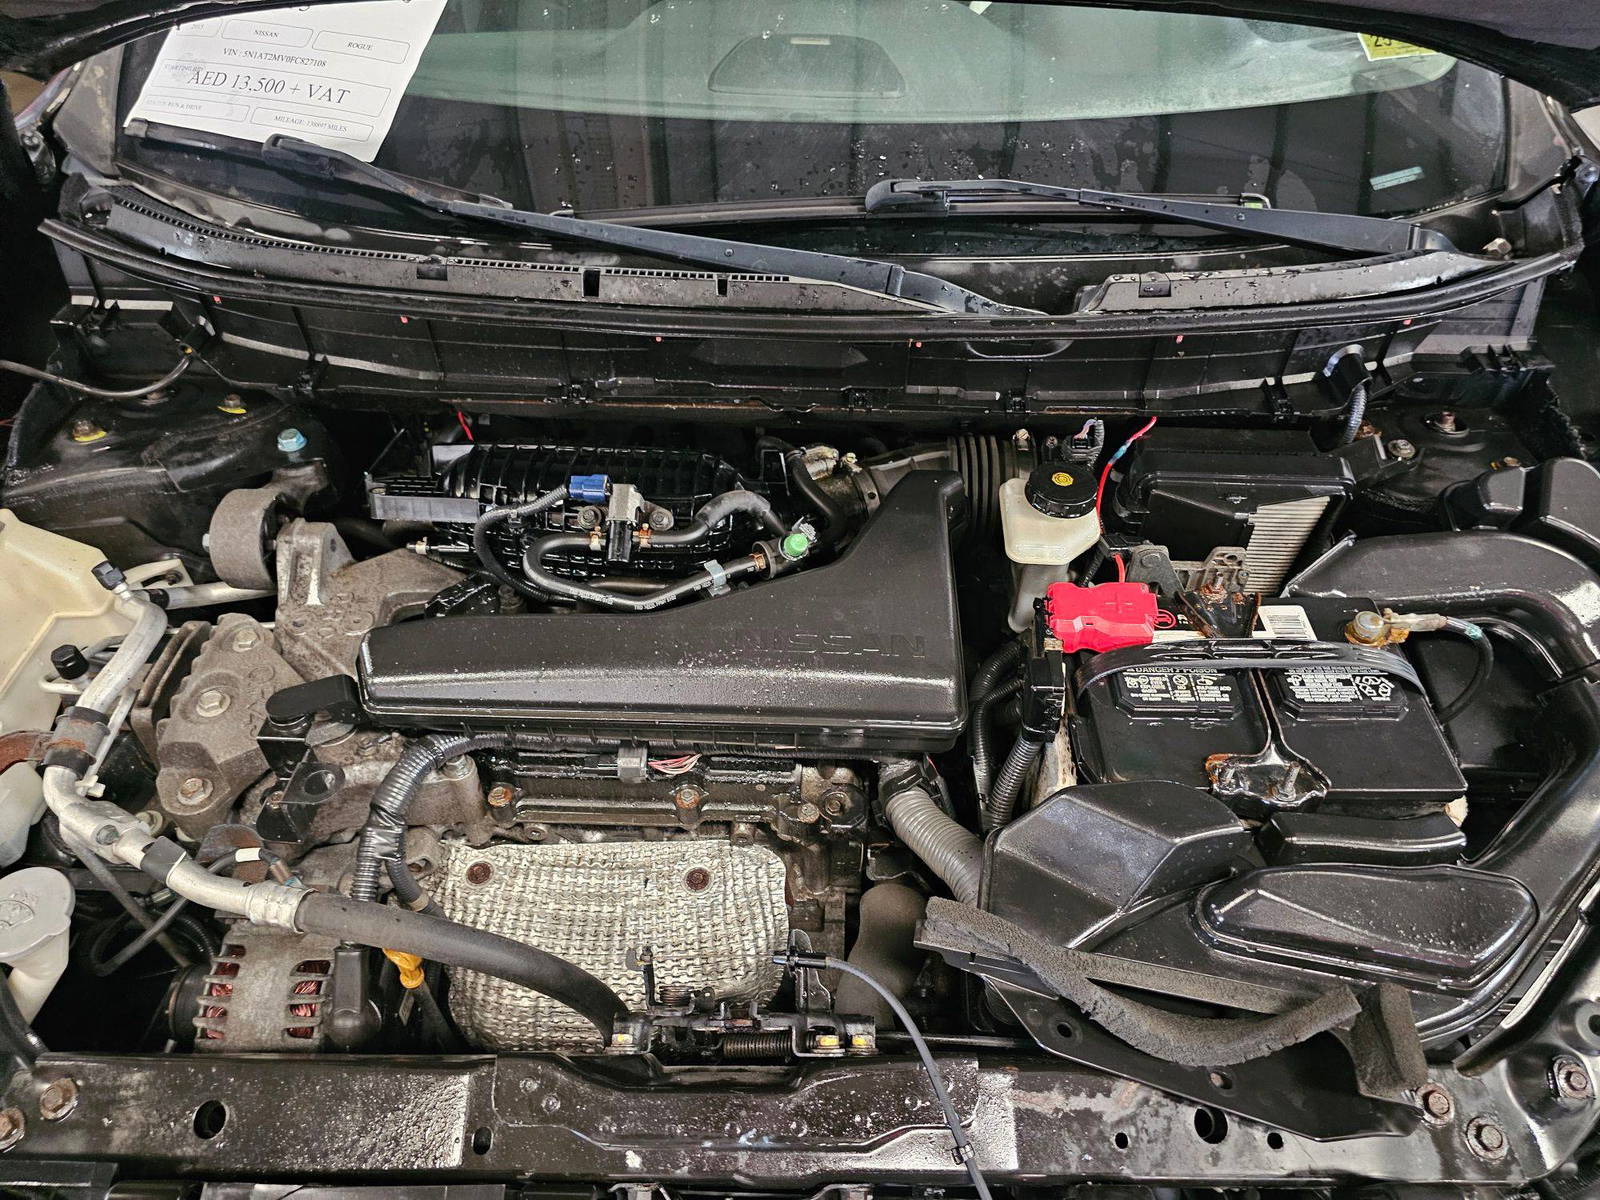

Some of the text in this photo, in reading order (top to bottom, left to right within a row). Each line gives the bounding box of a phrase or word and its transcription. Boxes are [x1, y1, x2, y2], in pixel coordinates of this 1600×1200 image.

[254, 29, 280, 38] NISSAN
[347, 41, 373, 51] ROGUE
[187, 71, 227, 87] AED
[289, 83, 301, 94] +
[309, 83, 351, 104] VAT
